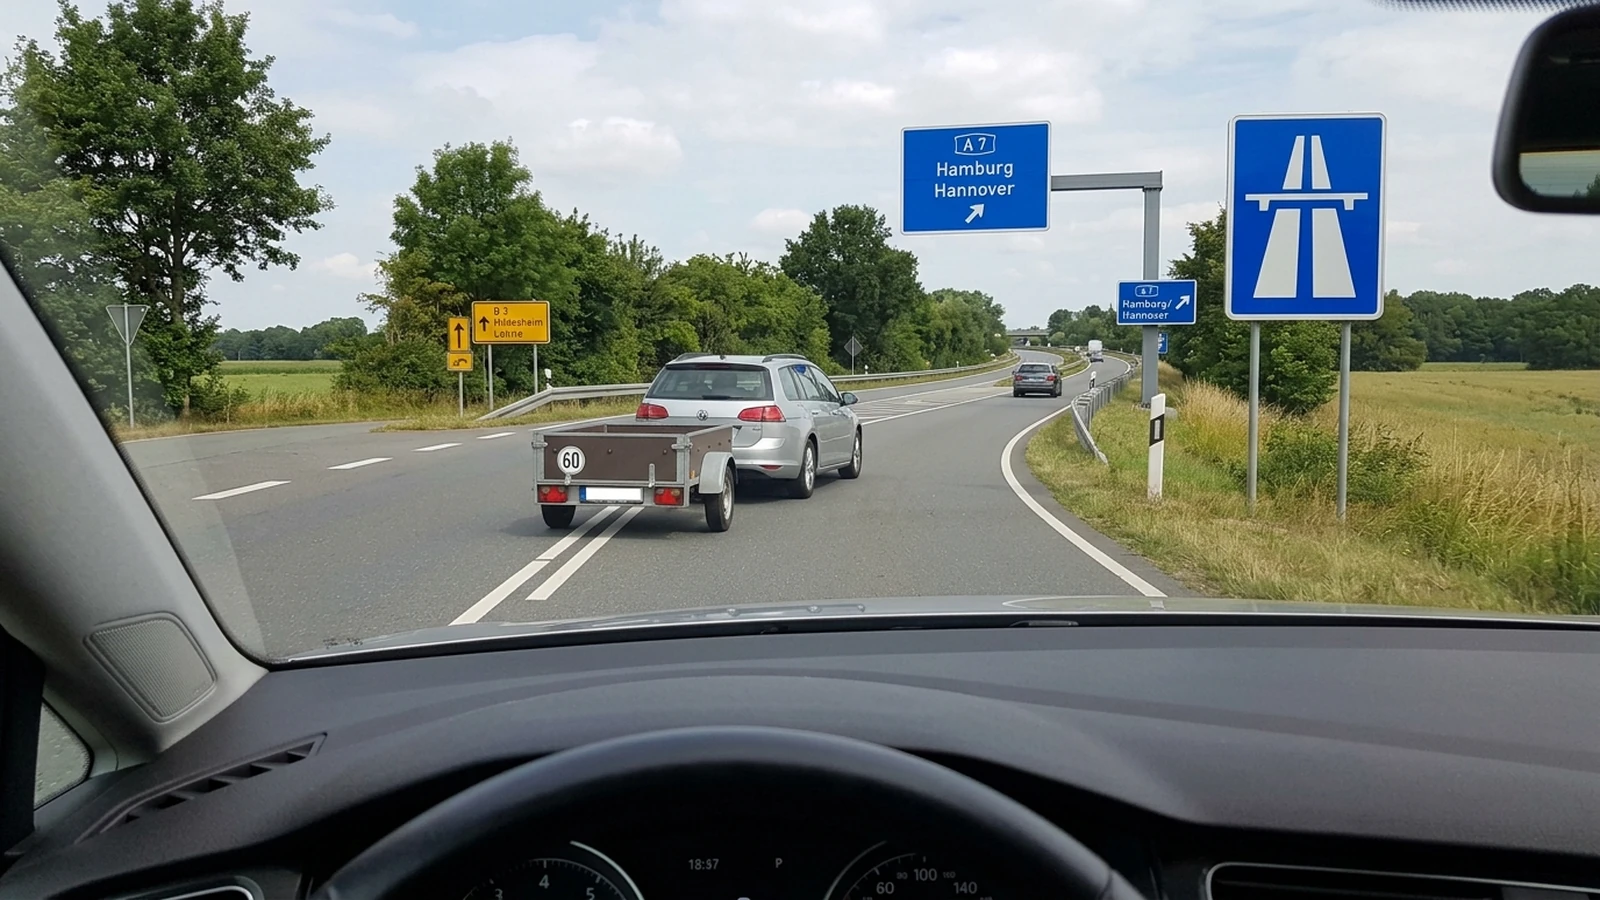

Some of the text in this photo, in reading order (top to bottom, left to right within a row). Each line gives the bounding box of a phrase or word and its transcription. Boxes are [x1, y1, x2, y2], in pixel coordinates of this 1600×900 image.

[963, 136, 987, 152] A 7
[936, 160, 1014, 179] Hamburg
[934, 183, 1016, 199] Hannover
[493, 306, 508, 316] B 3
[562, 451, 580, 469] 60
[774, 857, 784, 869] P
[538, 874, 550, 889] 4
[913, 867, 938, 882] 100
[585, 887, 596, 900] 5
[875, 881, 978, 895] 60 140
